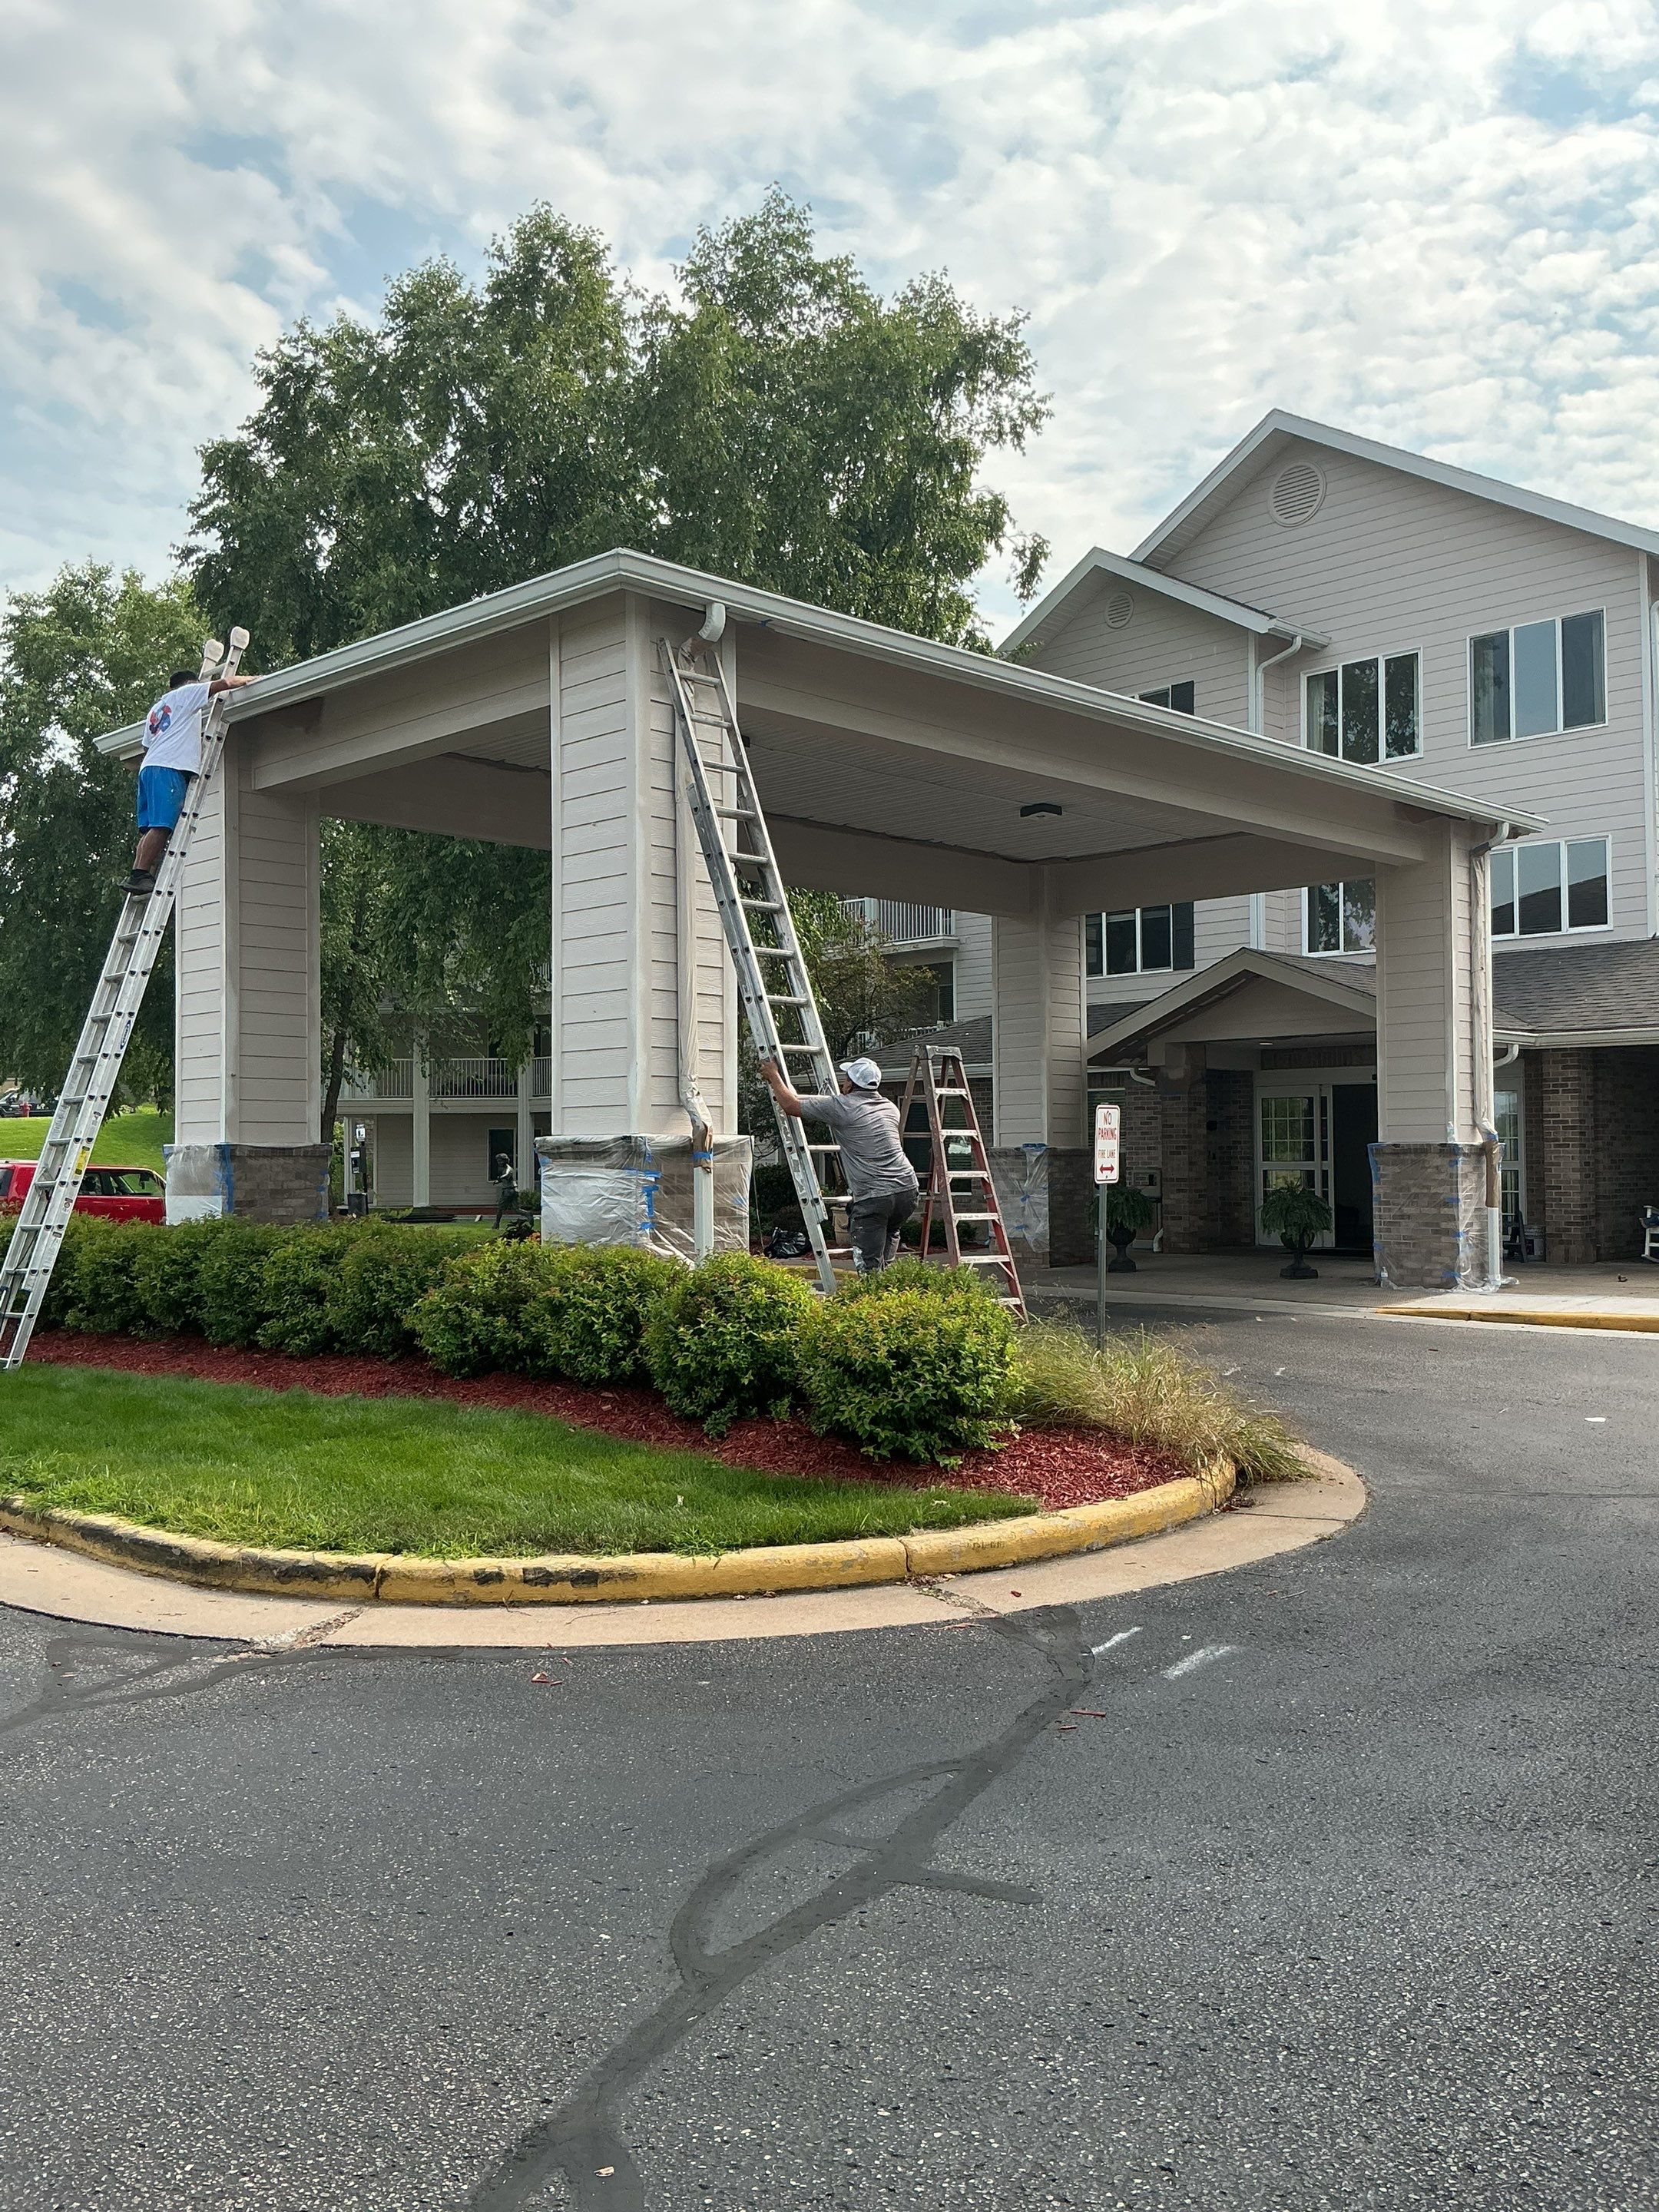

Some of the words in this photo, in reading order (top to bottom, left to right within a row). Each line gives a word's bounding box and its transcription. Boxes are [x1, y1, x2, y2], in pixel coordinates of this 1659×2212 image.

[1103, 1112, 1112, 1125] NO
[1098, 1128, 1117, 1141] PARKING
[1098, 1149, 1106, 1158] FIRE
[1107, 1149, 1116, 1158] LANE
